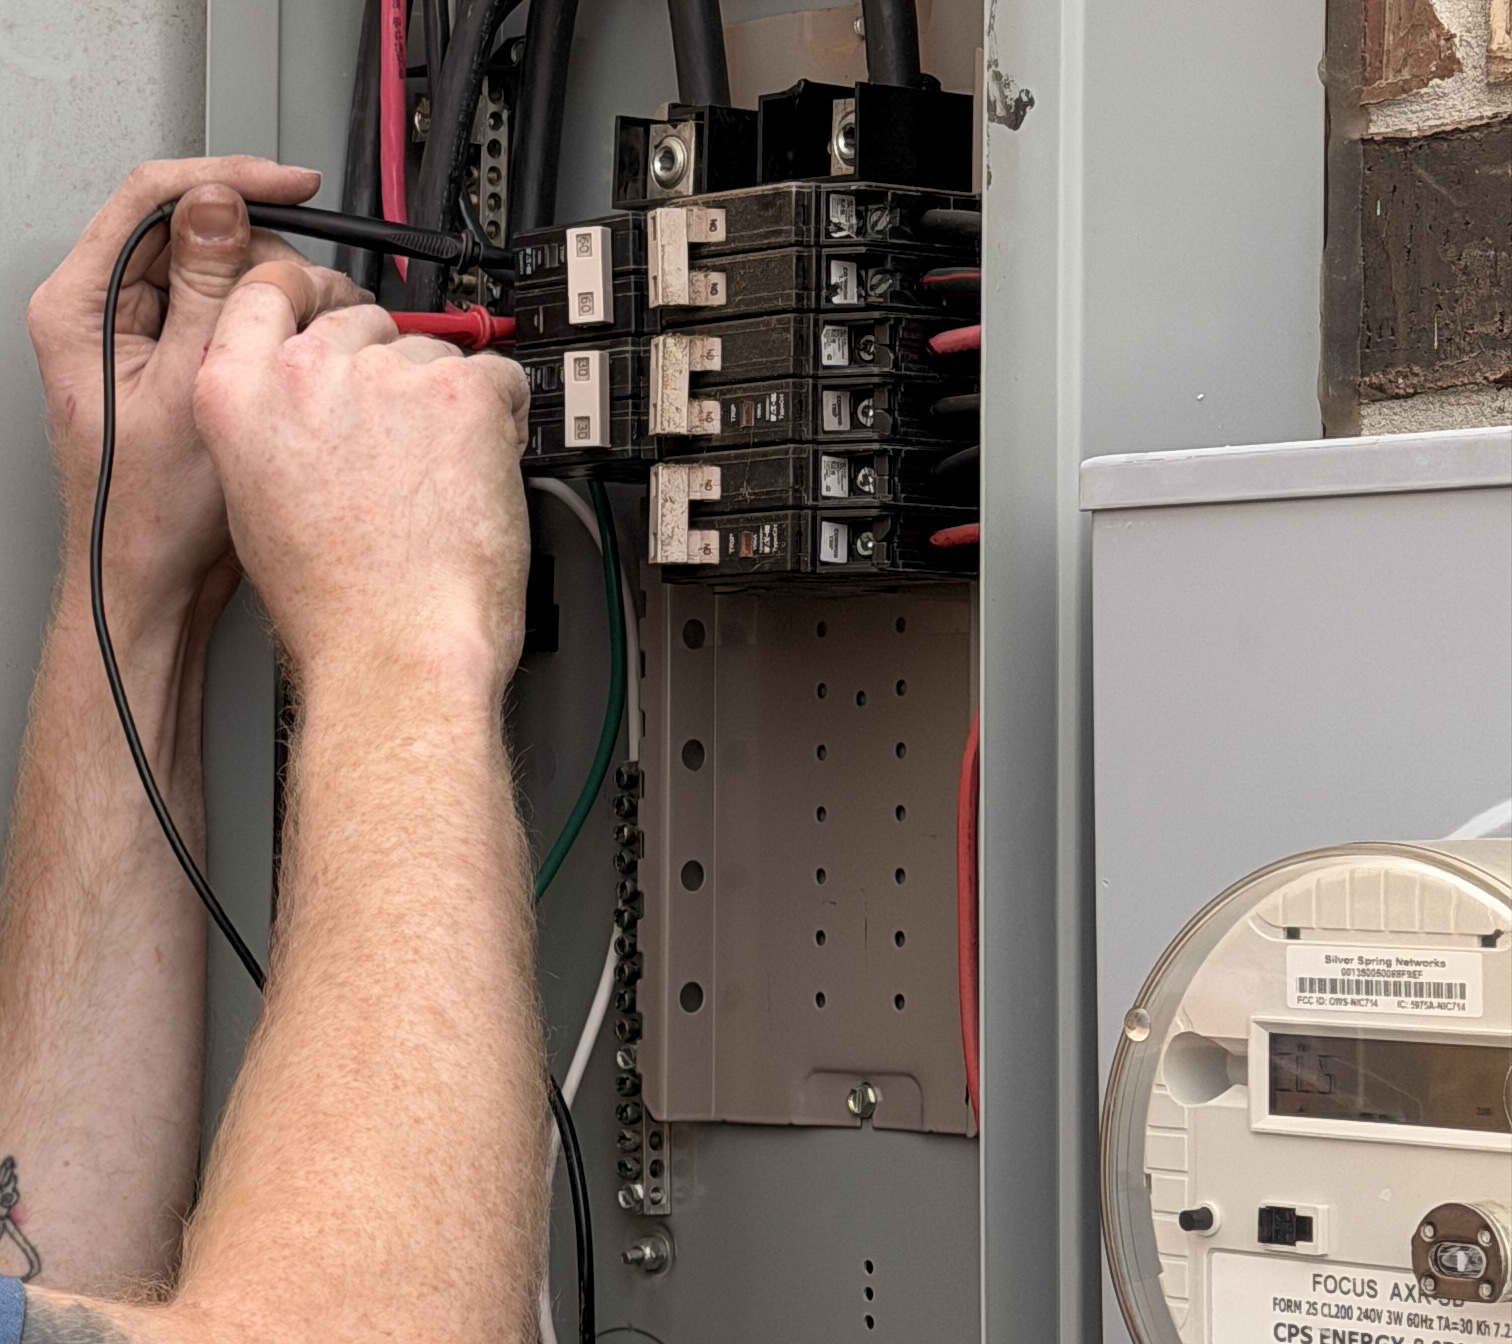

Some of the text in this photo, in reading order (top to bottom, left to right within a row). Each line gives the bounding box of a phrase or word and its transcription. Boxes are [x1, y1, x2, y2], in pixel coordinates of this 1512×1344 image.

[1323, 954, 1447, 969] Silver Spring Networks
[1296, 995, 1314, 1006] FCC
[1311, 1272, 1378, 1299] FOCUS
[1272, 1296, 1303, 1315] FORM
[1305, 1300, 1318, 1316] 2S
[1320, 1302, 1354, 1322] CL200
[1356, 1306, 1384, 1325] 240V
[1386, 1310, 1403, 1327] 3W
[1406, 1312, 1434, 1331] 60Hz
[1437, 1315, 1473, 1336] TA=30
[1476, 1320, 1491, 1337] Kh
